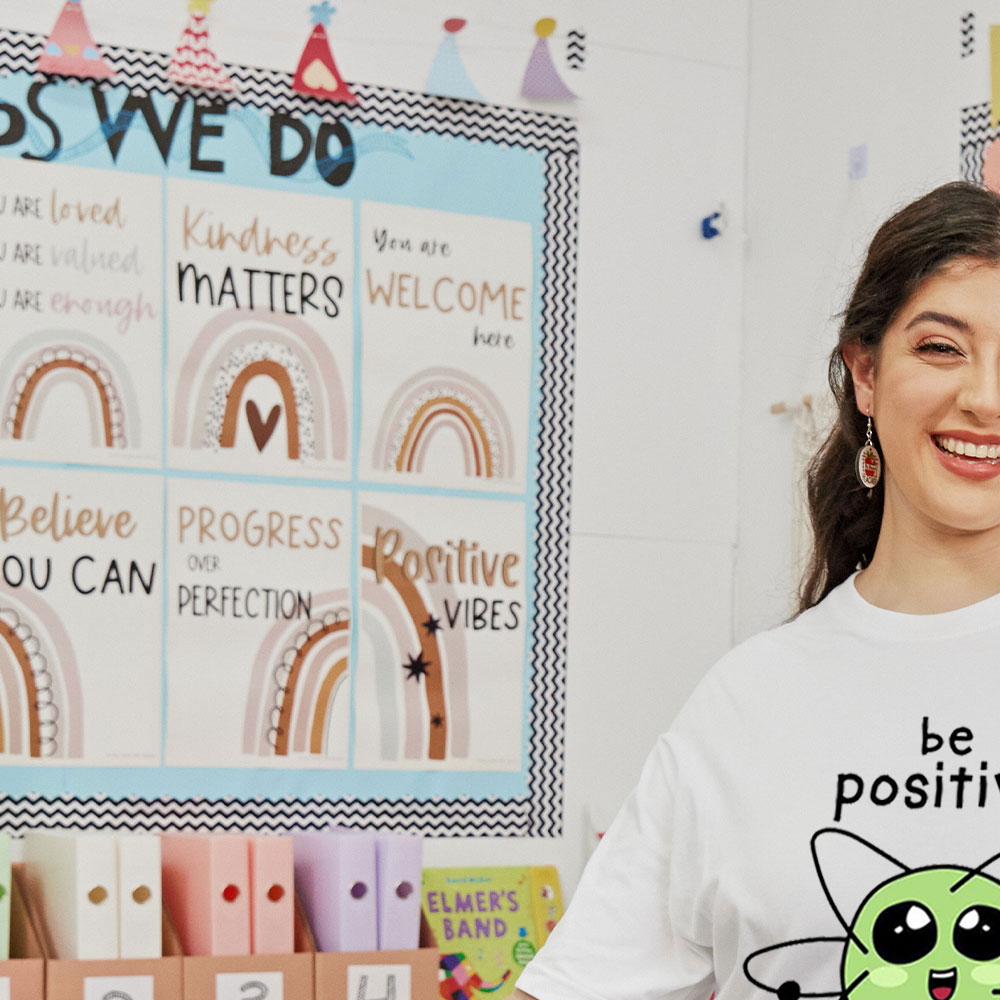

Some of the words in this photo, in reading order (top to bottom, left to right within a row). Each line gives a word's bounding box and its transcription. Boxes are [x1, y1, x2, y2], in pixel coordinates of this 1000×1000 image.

[90, 84, 228, 173] WE
[270, 111, 355, 187] DO
[13, 195, 43, 219] ARE
[51, 188, 126, 229] loved
[182, 205, 339, 267] Kindness
[373, 228, 415, 256] You
[419, 238, 451, 257] are
[13, 242, 43, 266] ARE
[51, 237, 144, 276] valued
[13, 289, 43, 313] ARE
[51, 291, 156, 335] enough
[365, 268, 526, 321] WELCOME
[472, 325, 515, 350] here
[0, 487, 137, 542] Believe
[179, 505, 343, 550] PROGRESS
[72, 555, 156, 595] CAN
[187, 554, 221, 573] OVER
[373, 526, 520, 589] Positive
[178, 583, 312, 621] PERFECTION
[443, 596, 522, 632] VIBES
[921, 716, 974, 756] be
[427, 890, 519, 913] ELMER'S
[443, 918, 507, 941] BAND
